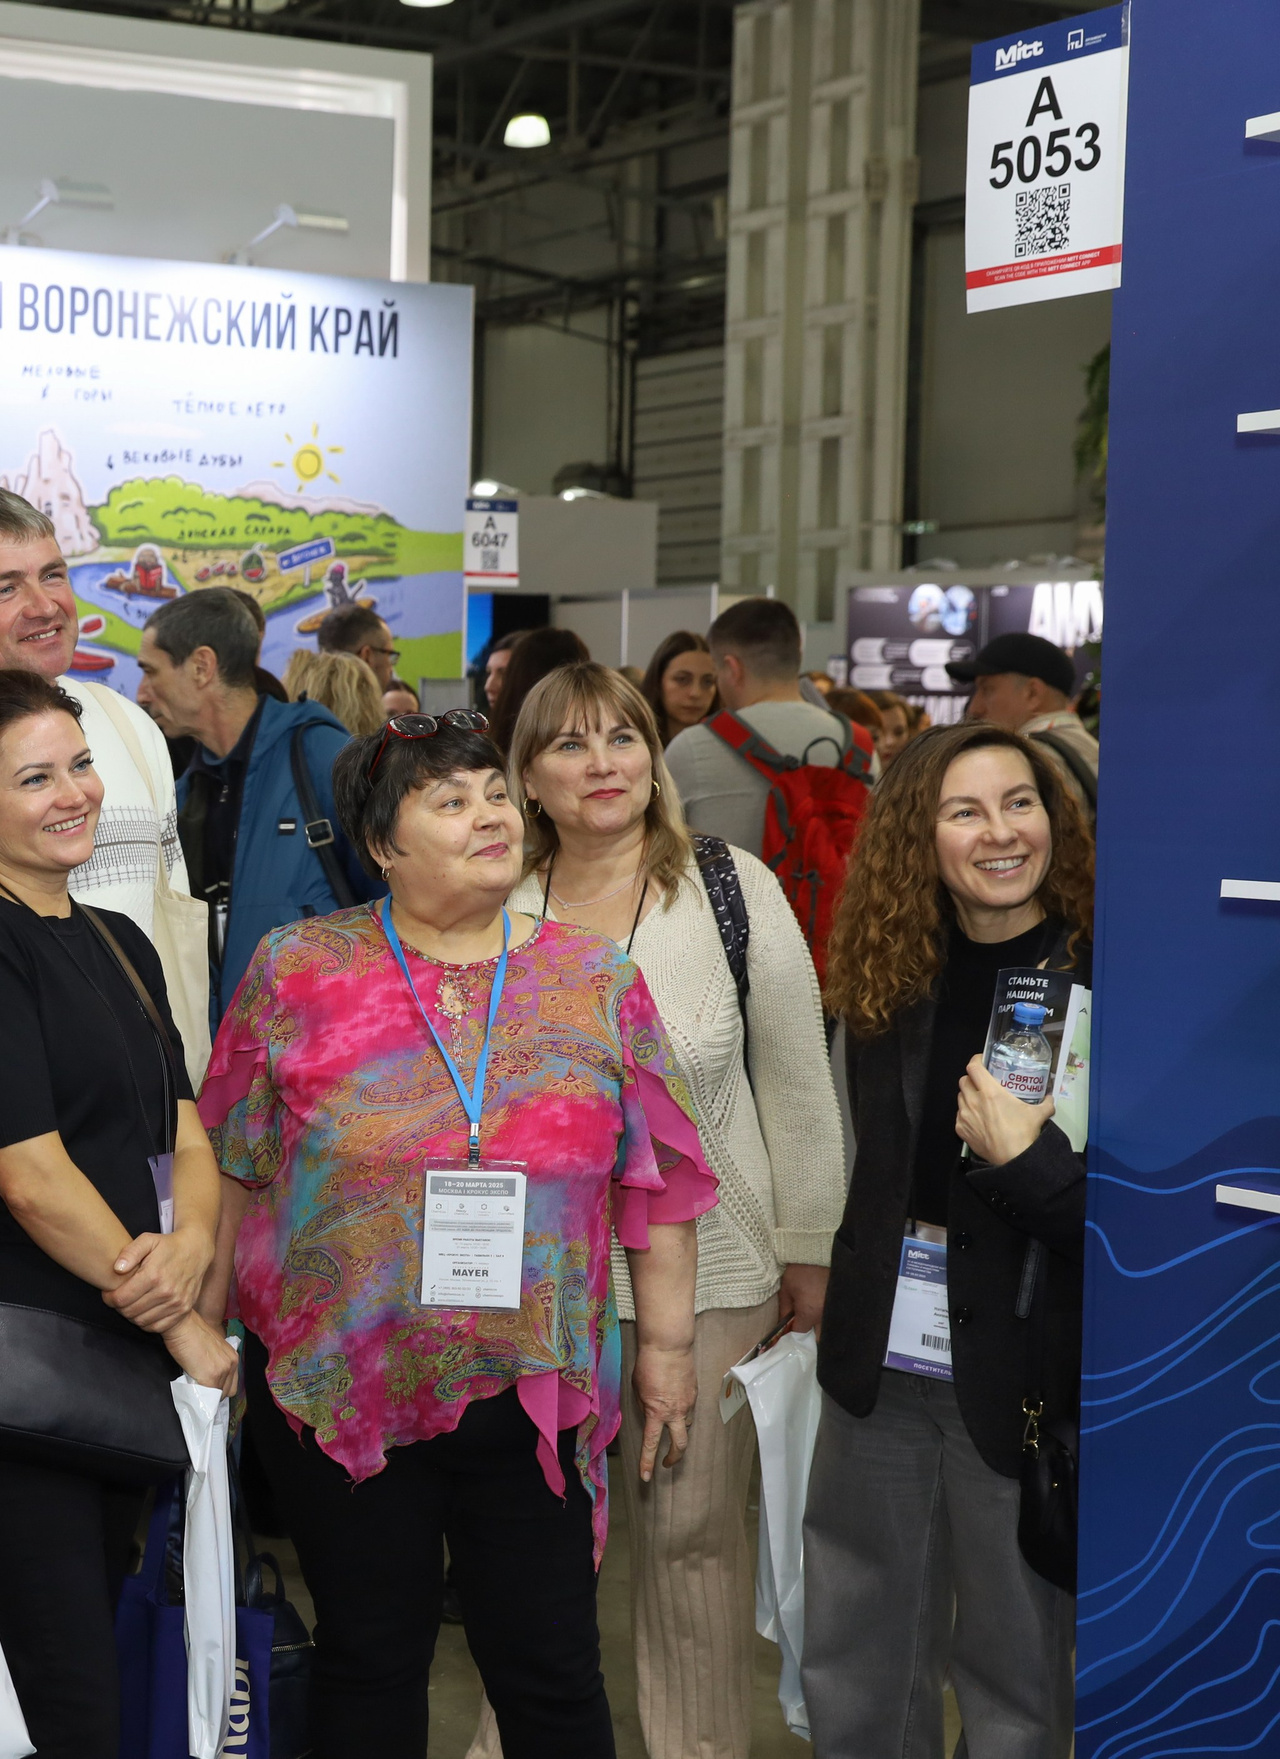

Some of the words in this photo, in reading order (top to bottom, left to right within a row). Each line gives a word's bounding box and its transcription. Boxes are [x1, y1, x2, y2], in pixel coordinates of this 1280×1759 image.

[995, 40, 1044, 69] Mitt
[1025, 76, 1063, 128] A
[989, 122, 1101, 189] 5053
[1079, 251, 1100, 260] CONNECT
[1060, 261, 1081, 270] CONNECT
[18, 282, 297, 351] ВОРОНЕЖСКИЙ
[310, 299, 400, 358] КРАЙ
[123, 449, 193, 465] ВЕКОВЫЕ
[198, 454, 243, 468] ДУБЫ
[471, 532, 508, 549] 6047
[1008, 976, 1049, 988] СТАНЬТЕ
[1006, 990, 1045, 1001] НАШИМ
[998, 1003, 1055, 1017] ПАРТМ
[452, 1268, 489, 1277] MAYER
[914, 1362, 952, 1376] ПОСЕТИТЕЛЬ
